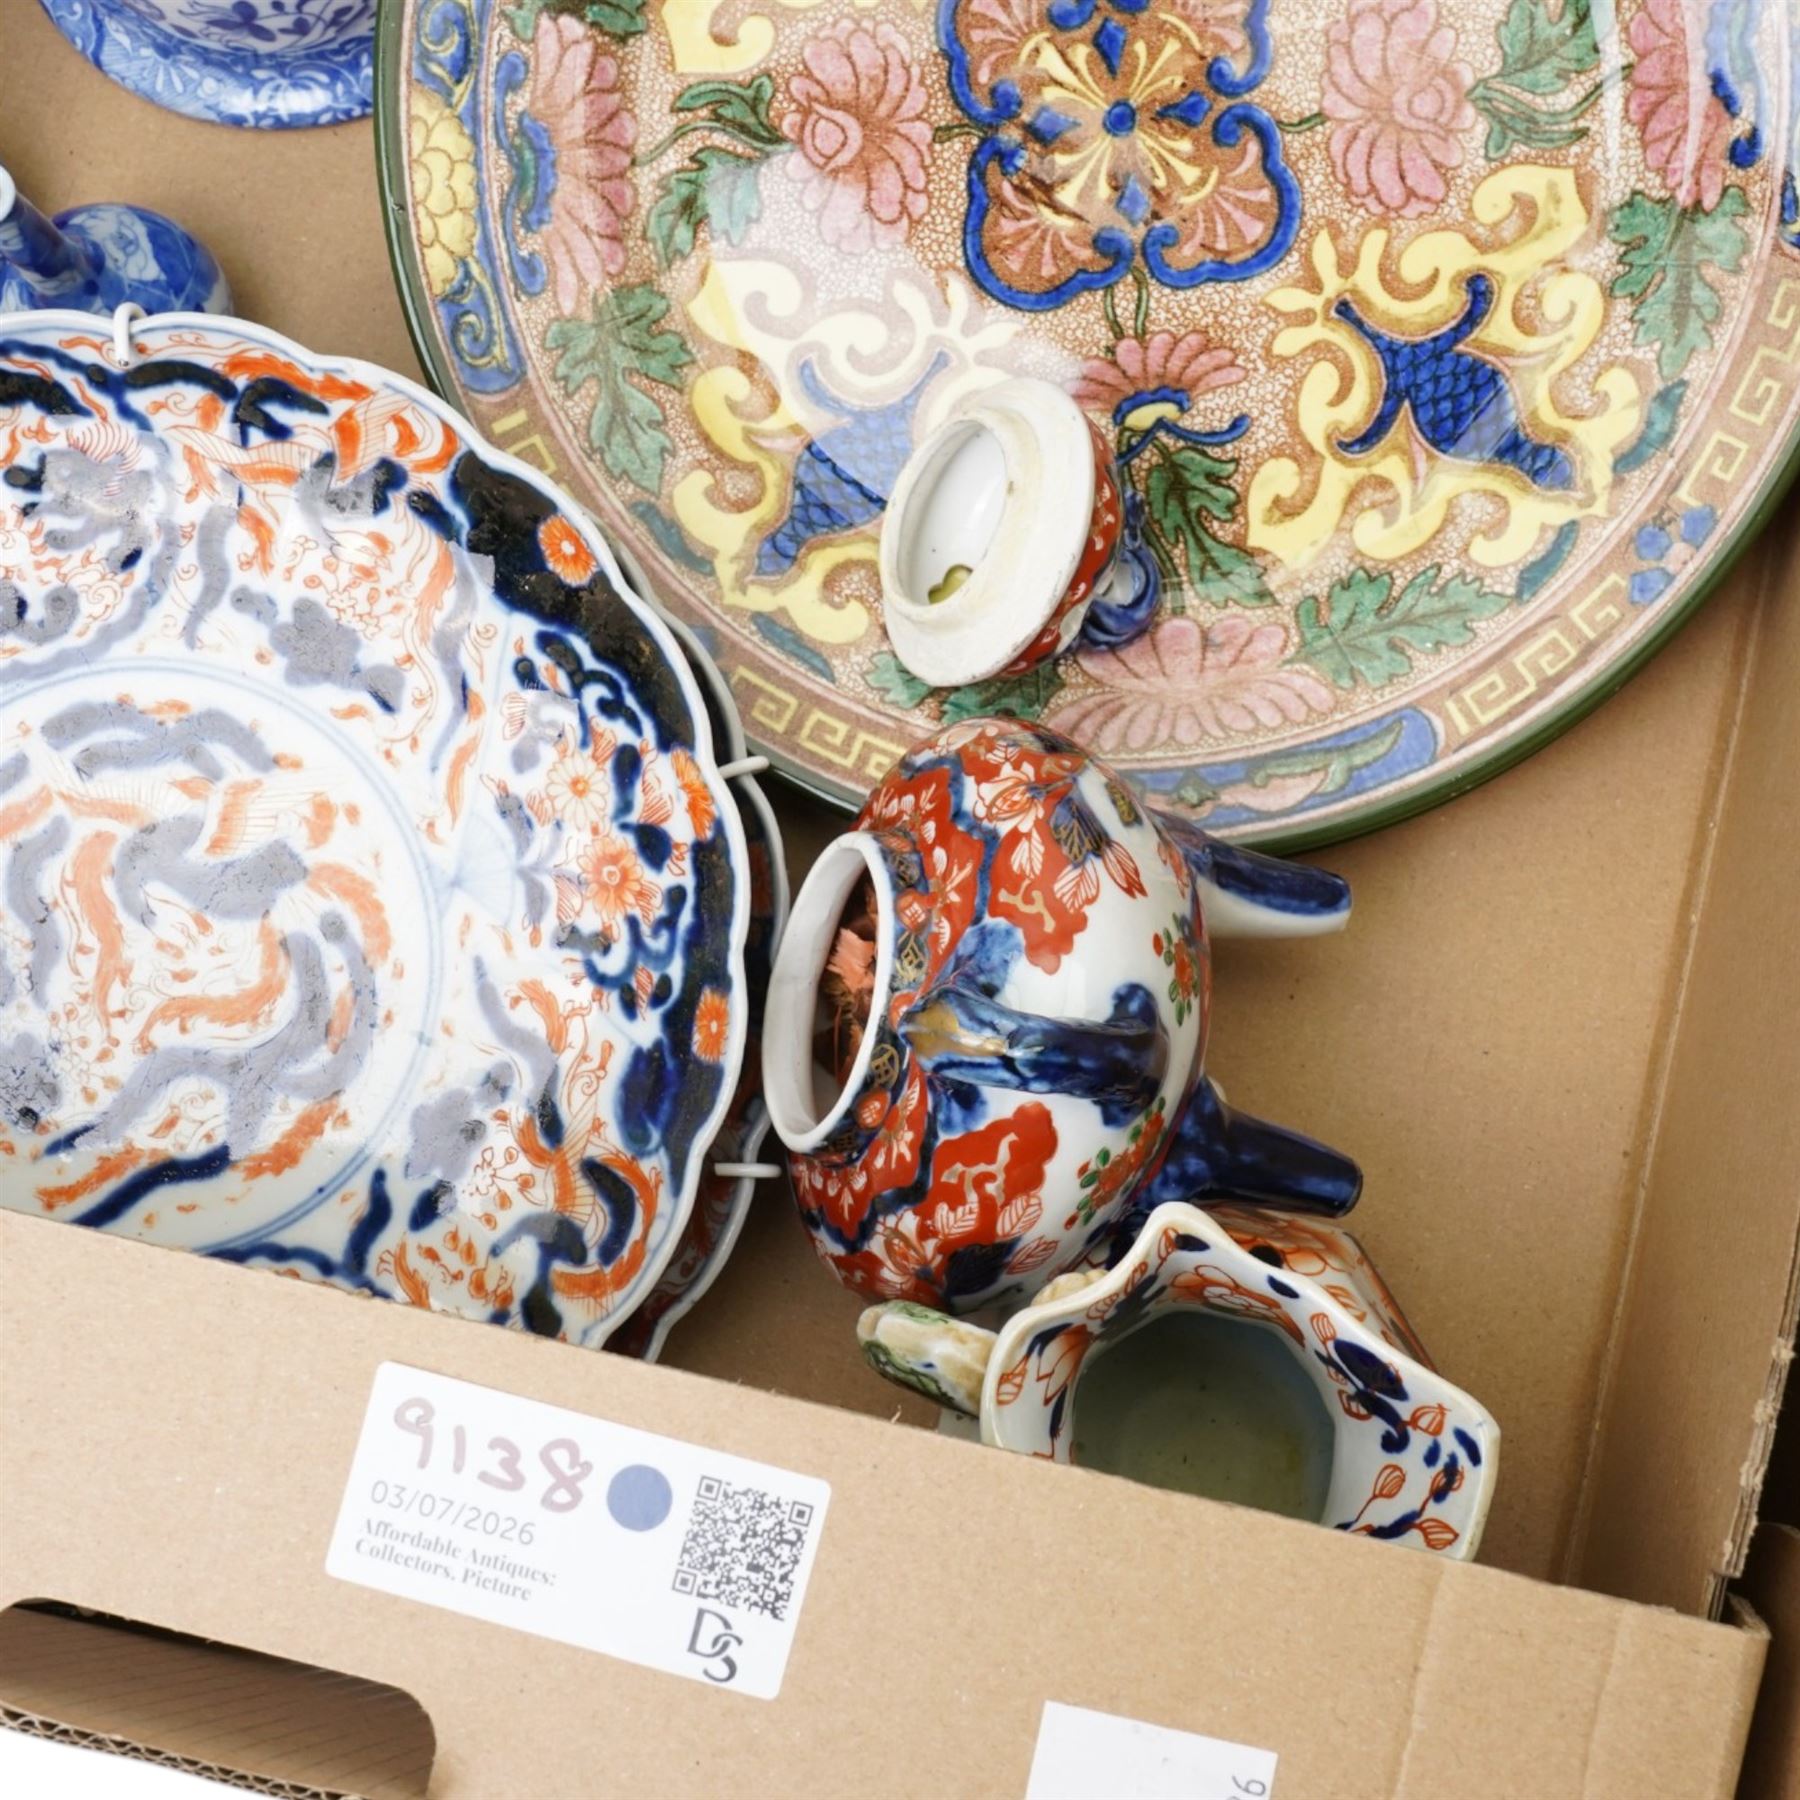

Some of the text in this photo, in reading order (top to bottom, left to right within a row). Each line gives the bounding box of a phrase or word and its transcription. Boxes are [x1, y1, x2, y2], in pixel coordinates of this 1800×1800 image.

[394, 1397, 593, 1513] 9138
[371, 1480, 536, 1545] 03/07/2026
[361, 1518, 557, 1586] Affordable Antiques:
[461, 1567, 532, 1601] Picture
